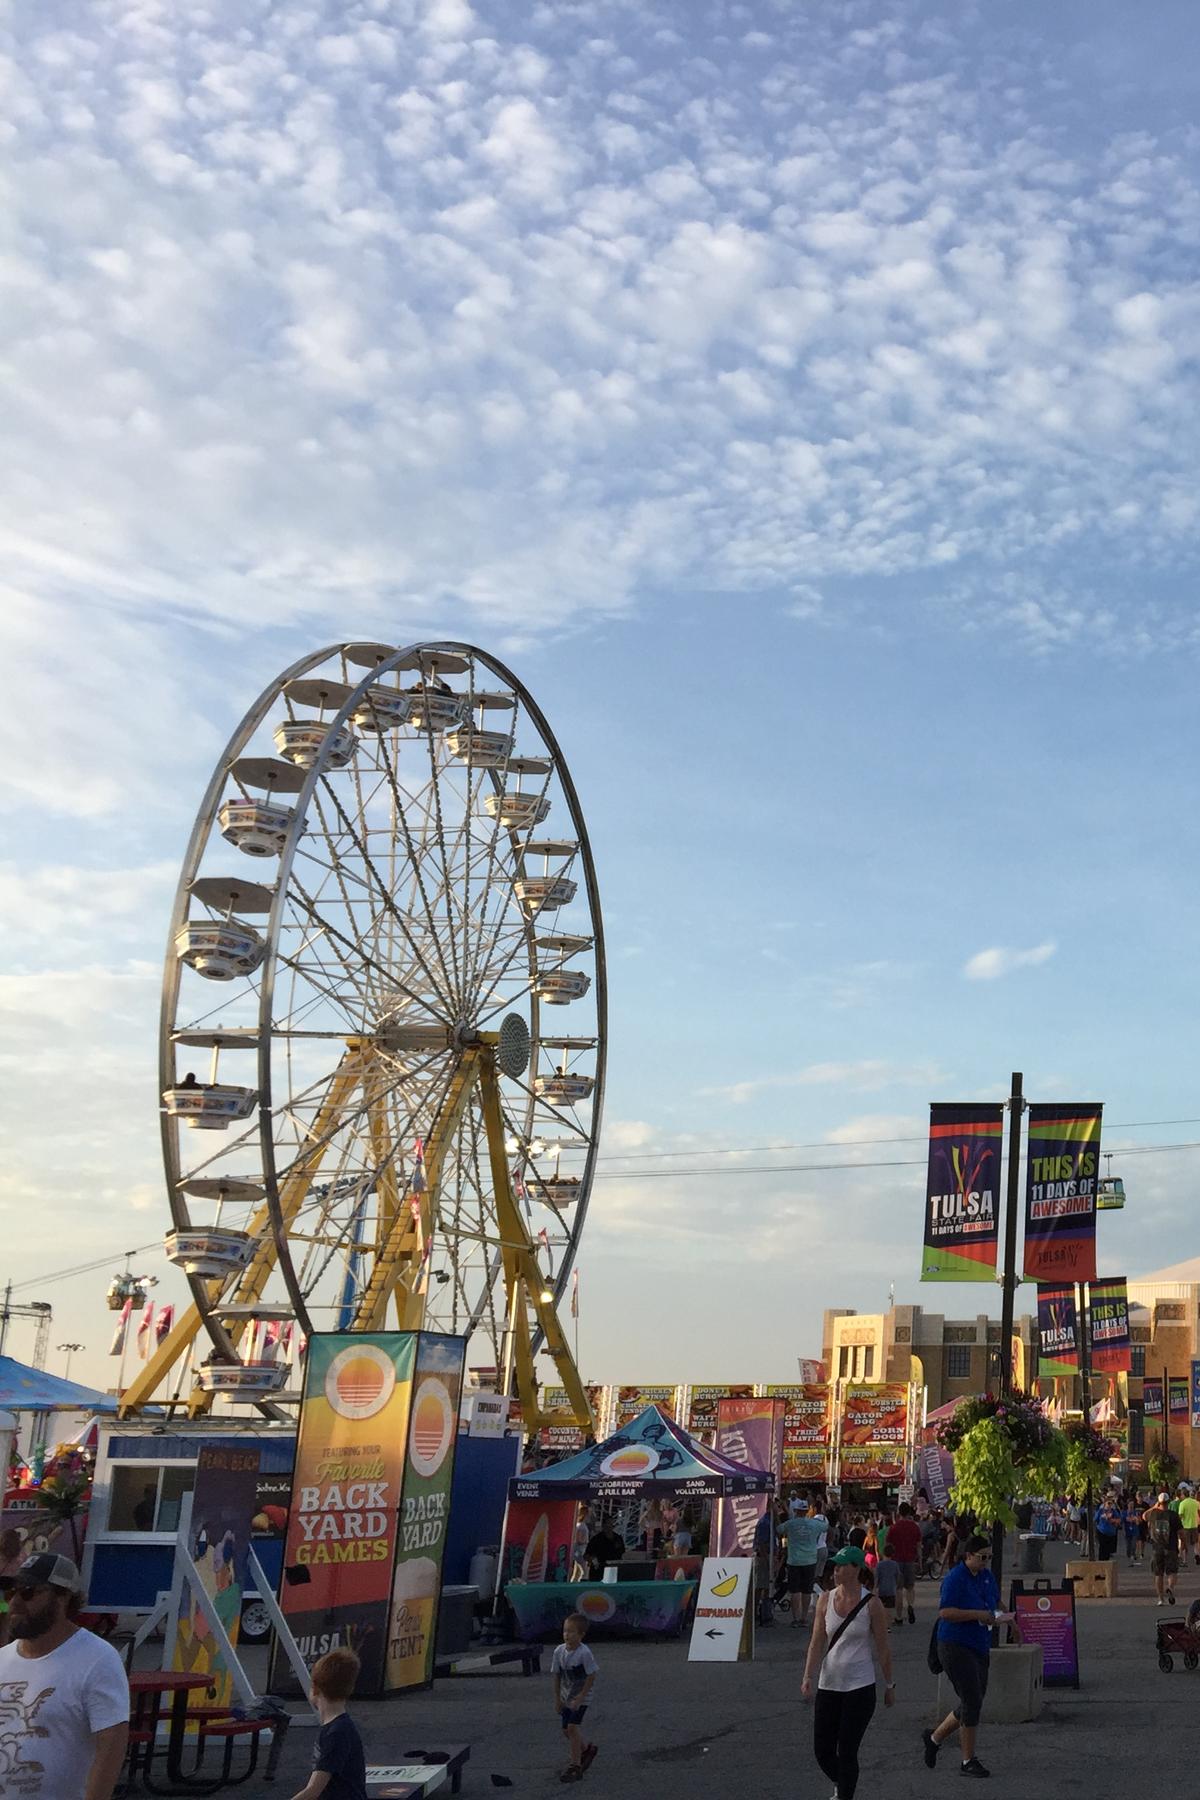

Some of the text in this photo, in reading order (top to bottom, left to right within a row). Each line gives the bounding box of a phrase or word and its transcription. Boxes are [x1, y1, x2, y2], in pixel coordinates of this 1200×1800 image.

[1032, 1152, 1095, 1182] THIS IS
[1032, 1179, 1095, 1200] 11 DAYS OF
[931, 1190, 993, 1219] TULSA
[1033, 1196, 1092, 1217] AWESOME
[932, 1213, 993, 1226] STATE FAIR
[932, 1227, 938, 1235] 11
[939, 1225, 954, 1234] DAYS
[964, 1221, 993, 1231] AWESOME
[1038, 1250, 1066, 1265] TULSA
[1092, 1303, 1127, 1320] THIS IS
[1101, 1319, 1117, 1328] DAYS
[1119, 1317, 1127, 1325] OF
[1040, 1326, 1074, 1345] TULSA
[322, 1445, 381, 1458] FEATURING YOUR
[315, 1457, 385, 1486] Favorite
[10, 1500, 37, 1509] ATM
[299, 1482, 389, 1512] BACK
[404, 1493, 446, 1523] BACK
[298, 1511, 388, 1541] YARD
[402, 1520, 443, 1551] YARD
[295, 1540, 388, 1564] GAMES
[695, 1607, 744, 1618] EMPANADAS
[390, 1634, 425, 1659] TENT
[366, 1767, 406, 1776] ULSA
